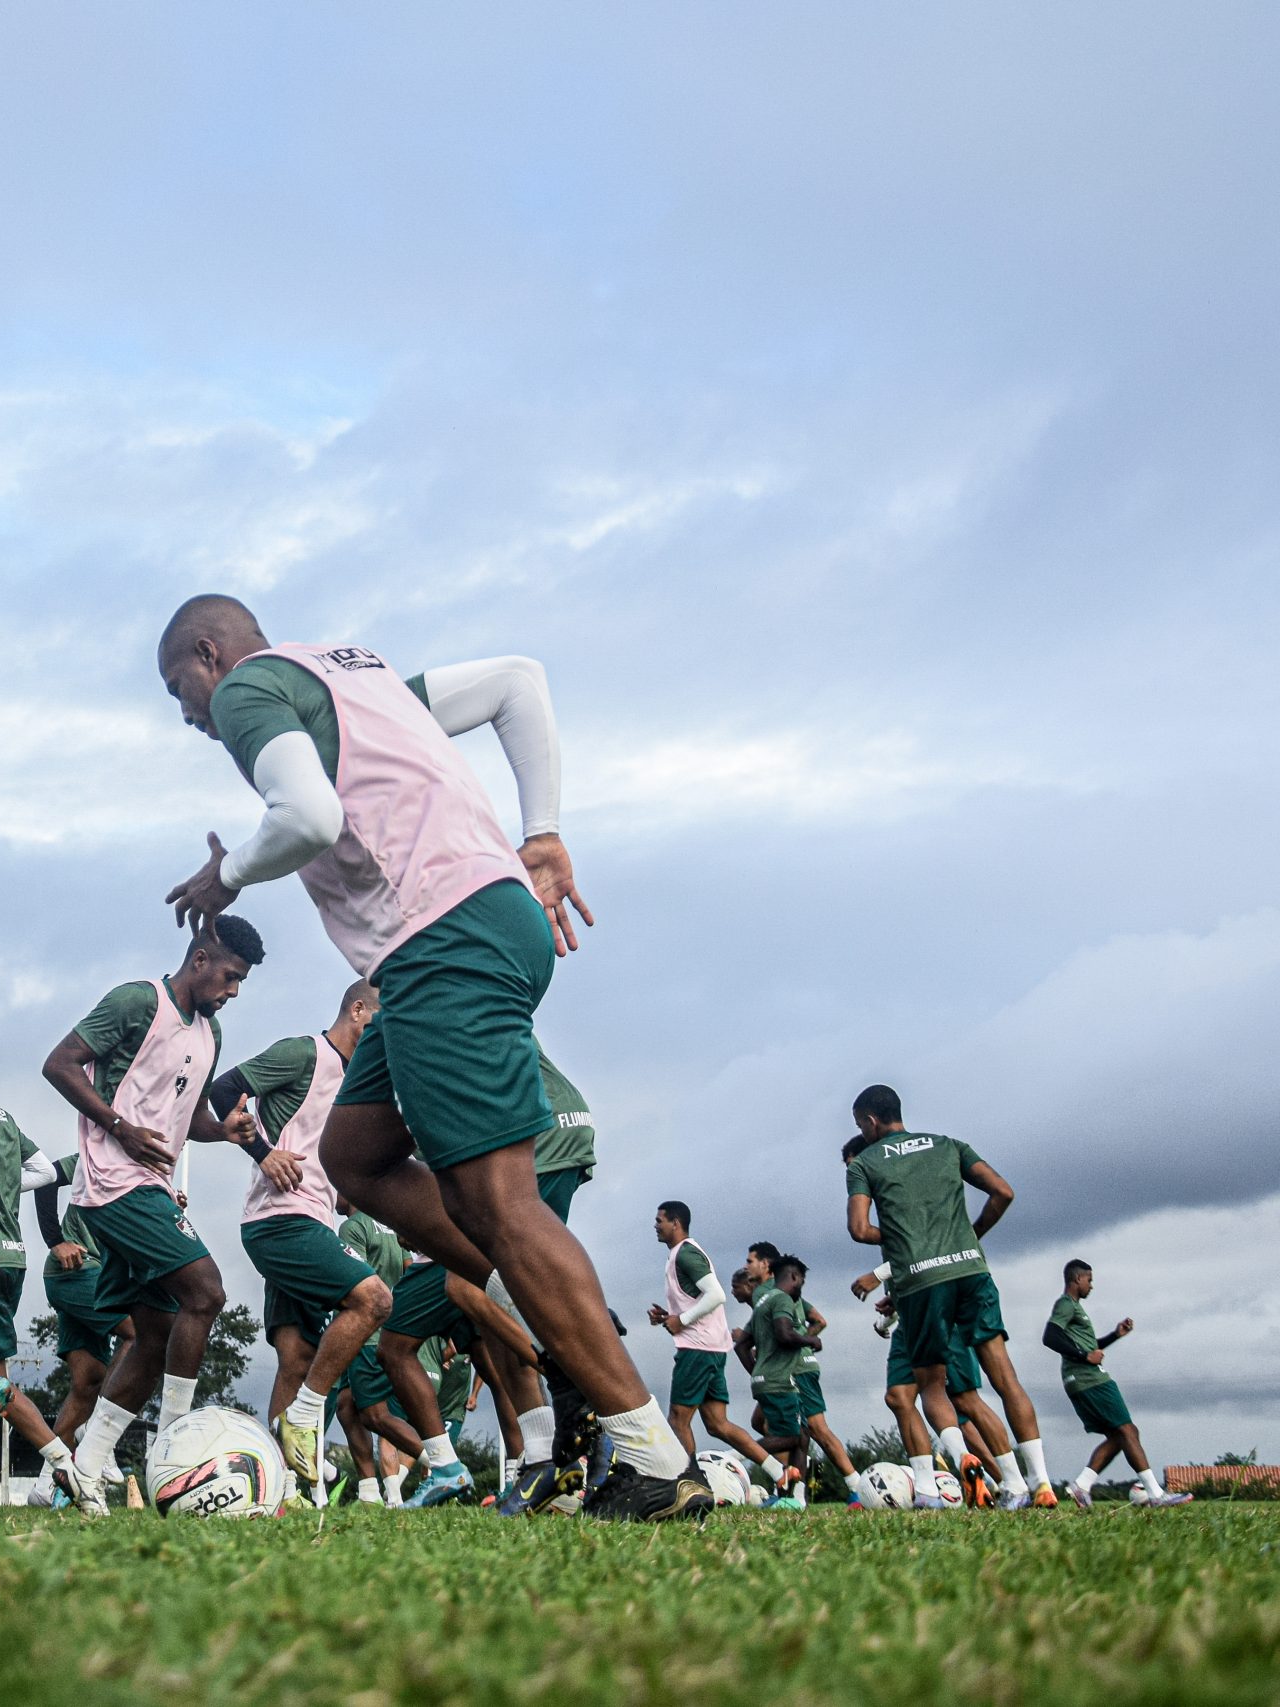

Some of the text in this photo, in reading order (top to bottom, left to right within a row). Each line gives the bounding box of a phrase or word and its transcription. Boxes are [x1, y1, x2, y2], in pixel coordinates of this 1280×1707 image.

[909, 1255, 953, 1274] FLUMINENSE
[952, 1252, 963, 1262] DE
[190, 1484, 214, 1498] VELOCITY
